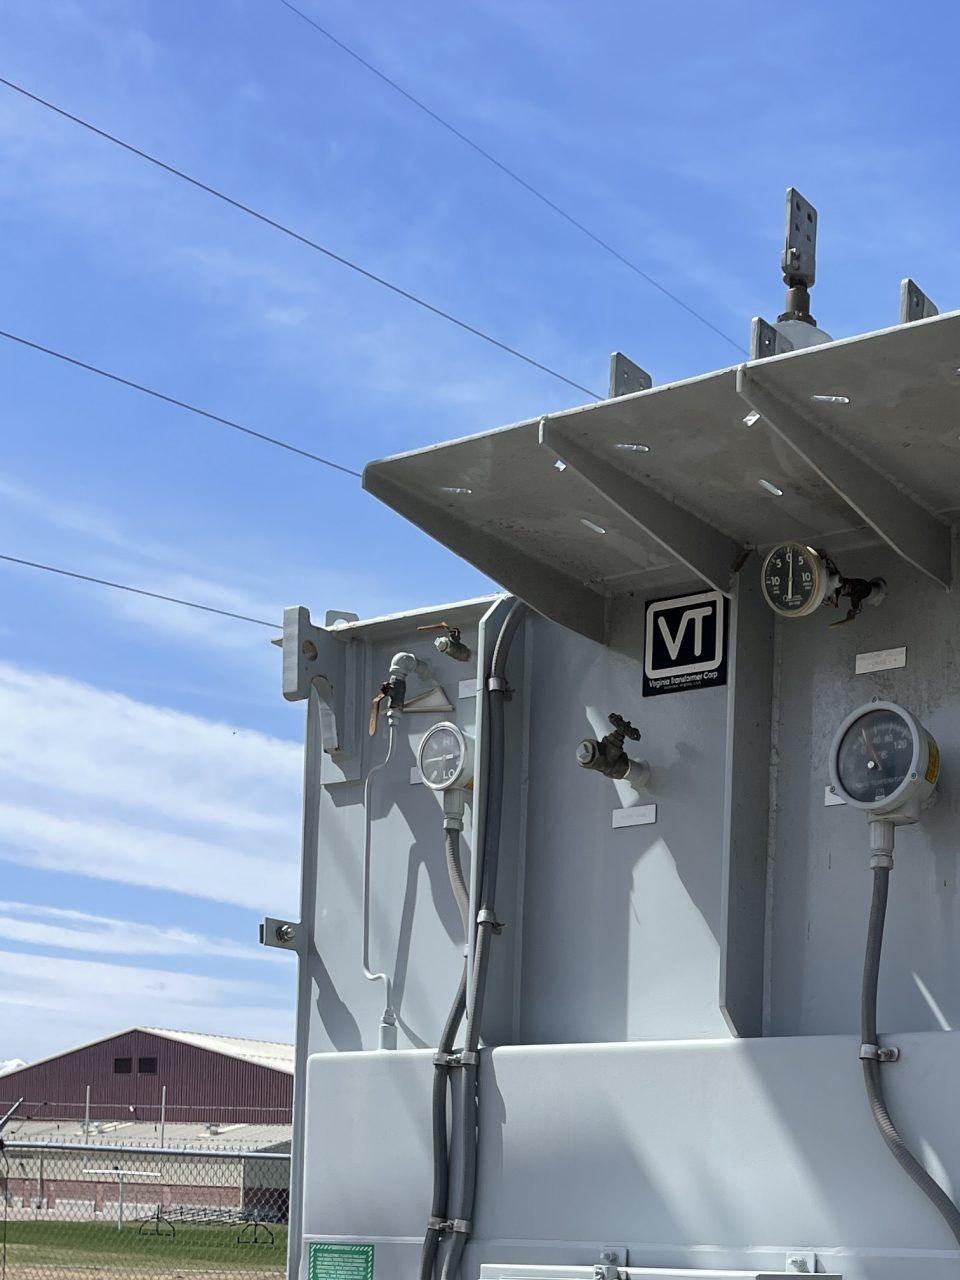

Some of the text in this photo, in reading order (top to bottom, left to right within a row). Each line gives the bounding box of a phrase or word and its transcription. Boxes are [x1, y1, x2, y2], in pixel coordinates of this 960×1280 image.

[776, 559, 782, 568] 5
[798, 556, 804, 566] 5
[770, 576, 780, 586] 10
[801, 572, 812, 582] 10
[657, 606, 713, 661] VT
[648, 678, 670, 688] Virginia
[670, 673, 703, 684] Transformer
[703, 671, 718, 680] Corp
[442, 736, 454, 747] HI
[442, 768, 455, 779] LO
